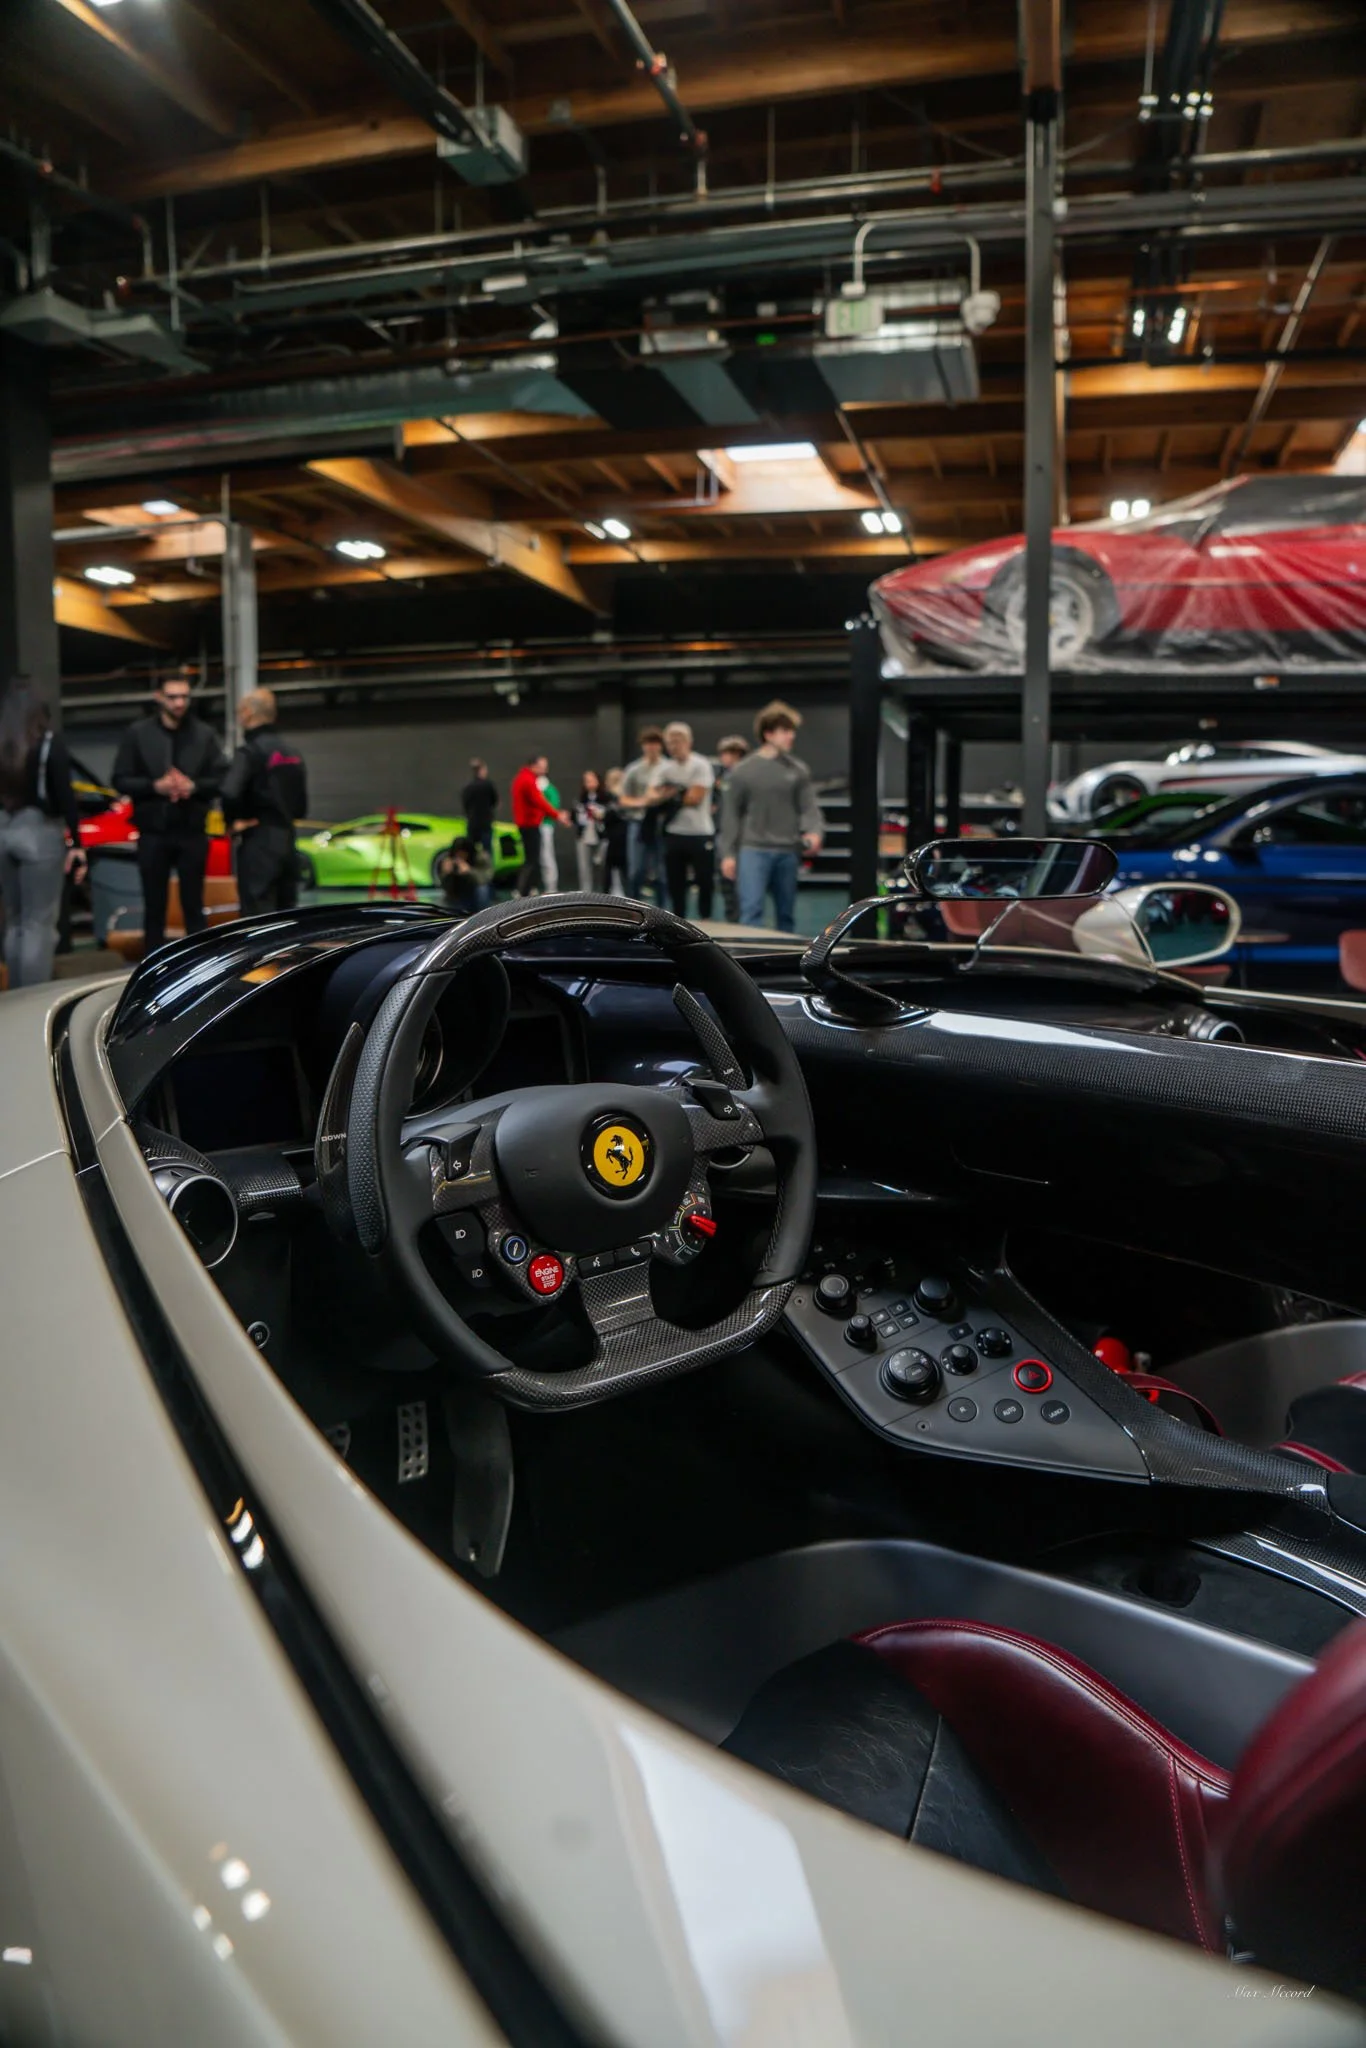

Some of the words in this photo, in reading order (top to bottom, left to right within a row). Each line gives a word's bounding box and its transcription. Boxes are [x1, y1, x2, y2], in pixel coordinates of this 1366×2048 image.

[321, 1132, 347, 1142] DOWN
[534, 1265, 559, 1278] ENGINE
[541, 1273, 556, 1282] START
[543, 1280, 557, 1289] STOP
[959, 1406, 967, 1414] R
[1002, 1406, 1017, 1417] AUTO
[1048, 1407, 1065, 1419] LAUNCH
